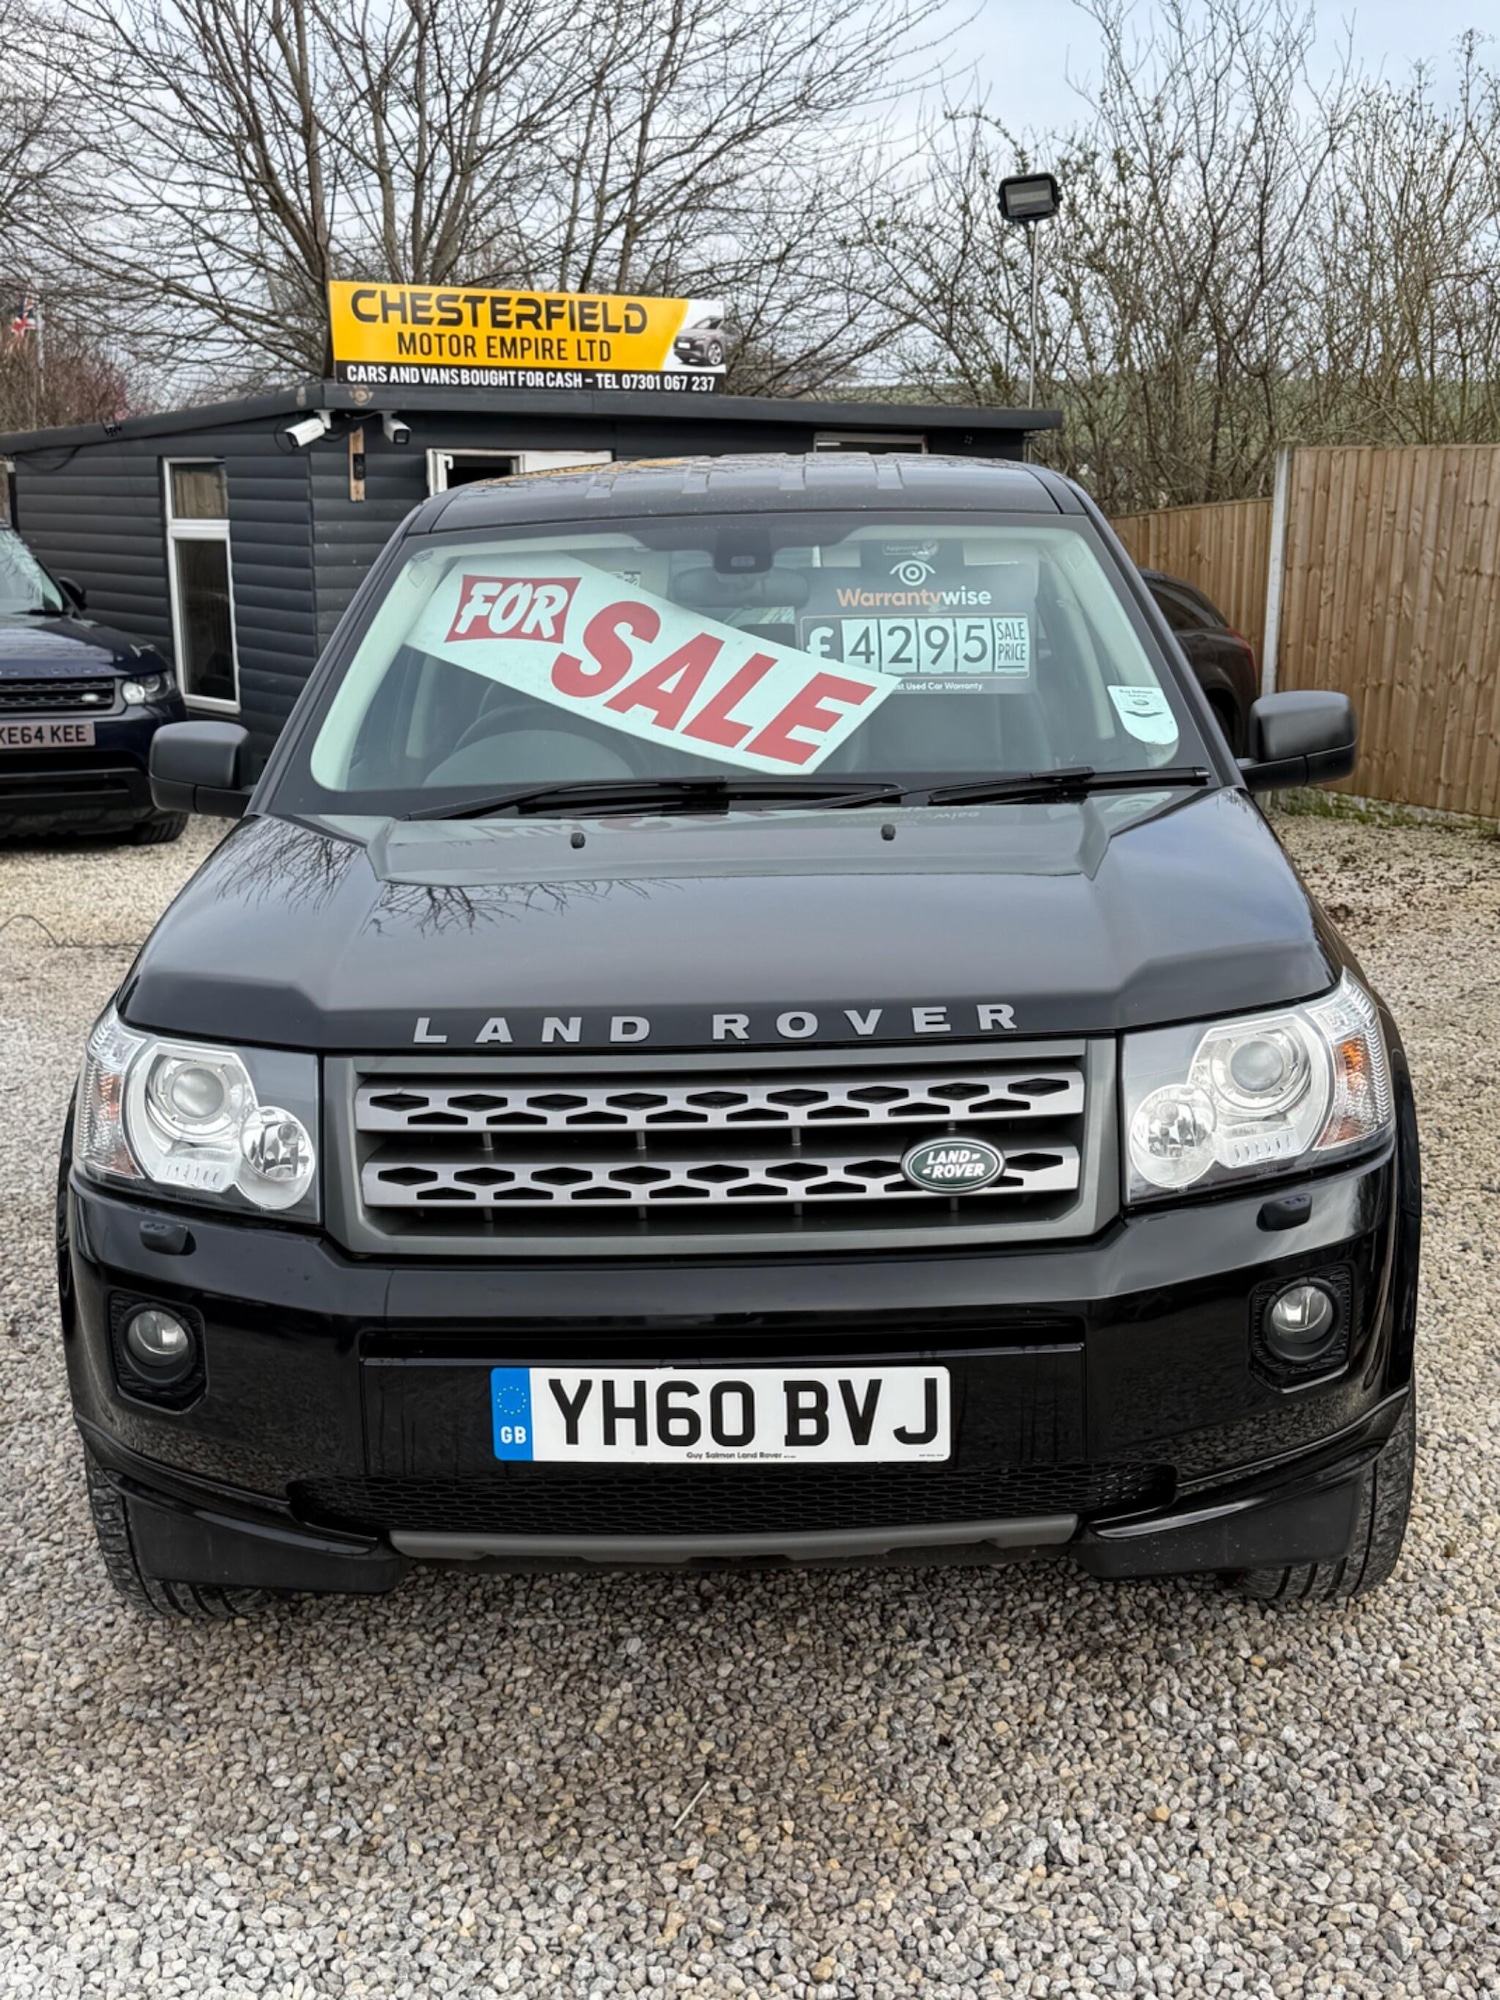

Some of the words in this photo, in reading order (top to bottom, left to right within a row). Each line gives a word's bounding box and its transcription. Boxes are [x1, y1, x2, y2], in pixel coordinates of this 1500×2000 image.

[350, 289, 647, 334] CHESTERFIELD
[397, 331, 477, 357] MOTOR
[486, 335, 568, 361] EMPIRE
[577, 339, 611, 362] LTD
[346, 365, 387, 383] CARS
[389, 366, 420, 384] AND
[420, 367, 460, 385] VANS
[460, 369, 516, 387] BOUGHT
[517, 371, 544, 387] FOR
[545, 372, 583, 388] CASH
[595, 373, 620, 389] TEL
[621, 373, 660, 390] 07301
[663, 375, 689, 391] 067
[691, 376, 715, 391] 237
[836, 586, 992, 608] Warrantywise
[996, 621, 1026, 641] SALE
[997, 642, 1026, 662] PRICE
[455, 581, 569, 640] FOR
[551, 600, 878, 766] SALE
[906, 682, 926, 690] Used
[927, 682, 943, 690] Car
[50, 725, 86, 743] KEE
[413, 1015, 650, 1044] LAND
[712, 1003, 1018, 1040] ROVER
[926, 1150, 971, 1165] LAND
[931, 1163, 985, 1179] ROVER
[548, 1378, 756, 1447] YH60
[783, 1377, 938, 1446] BVJ
[500, 1426, 526, 1444] GB
[686, 1452, 703, 1460] Guy
[705, 1451, 735, 1459] Salmon
[737, 1451, 757, 1459] Land
[759, 1451, 783, 1459] Rover
